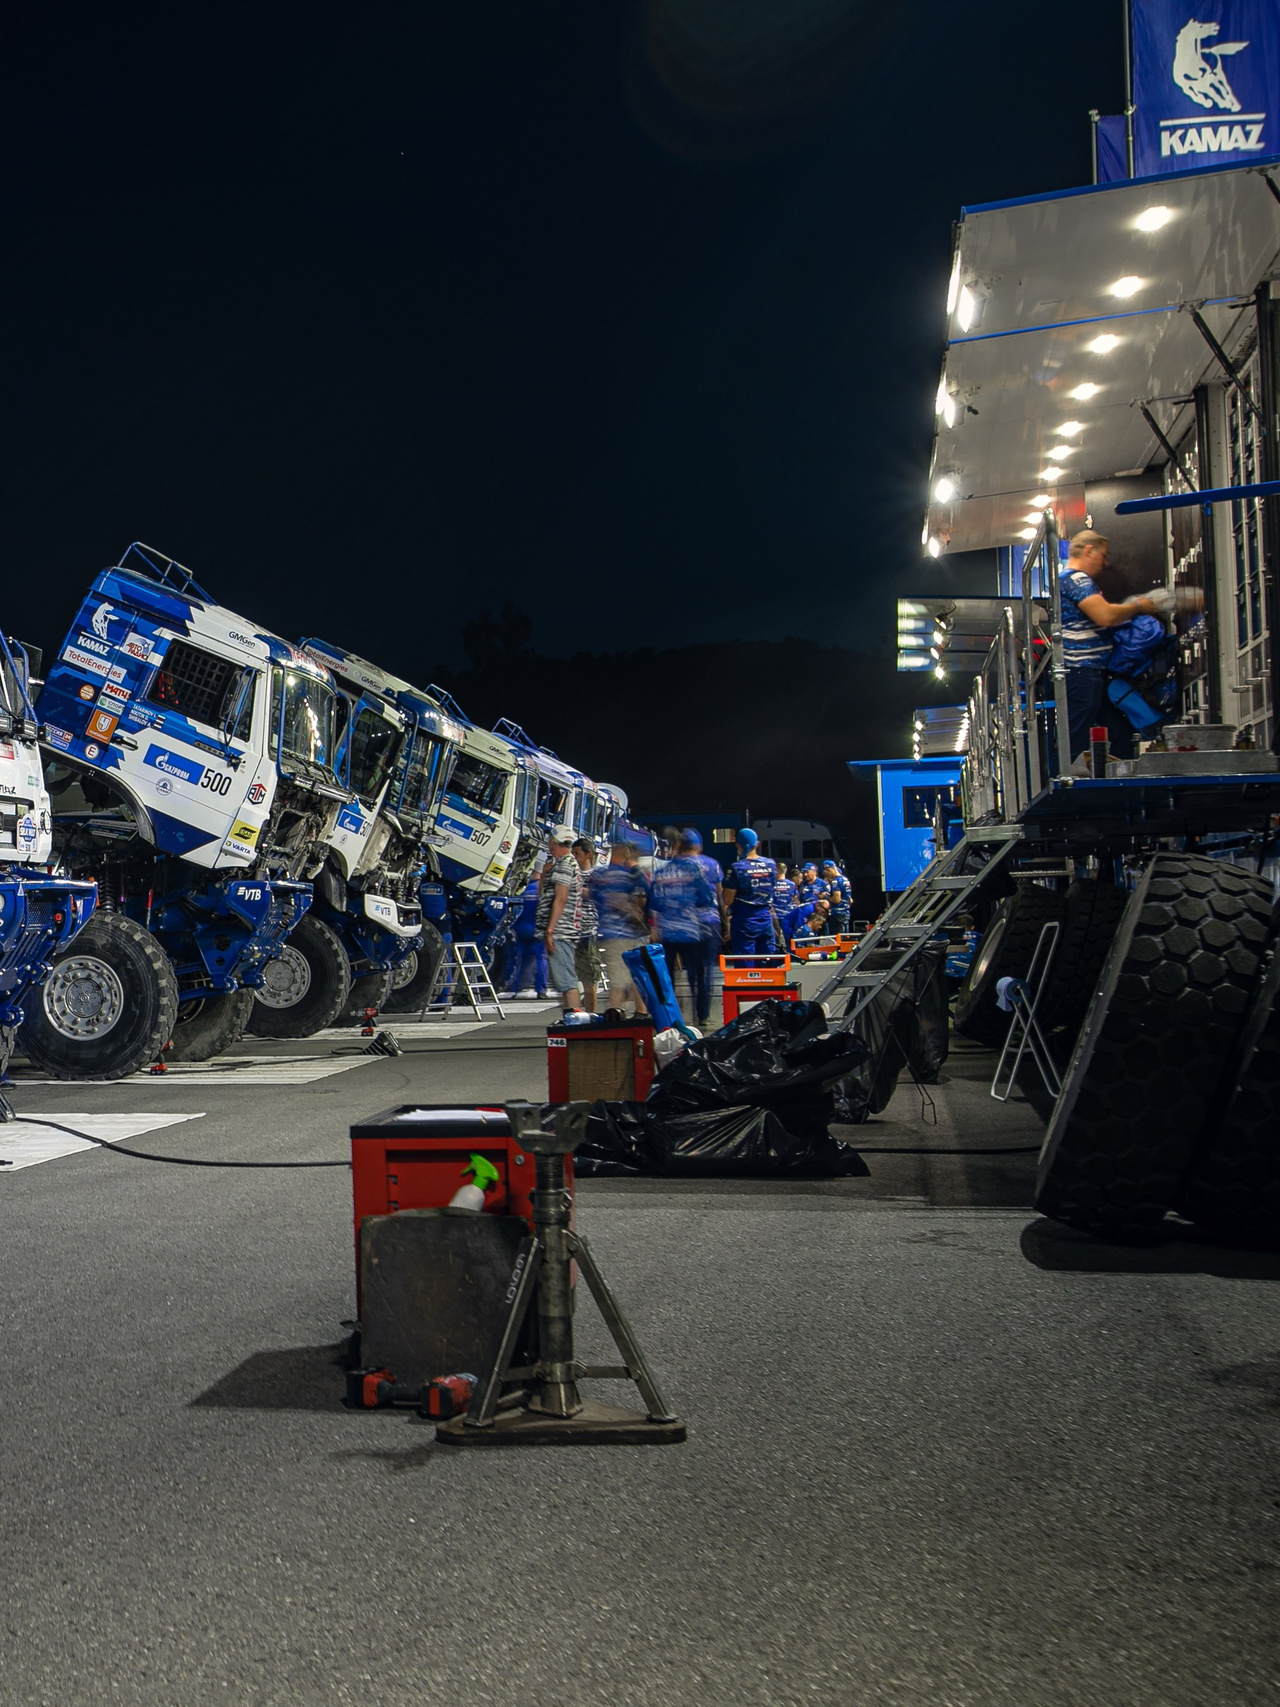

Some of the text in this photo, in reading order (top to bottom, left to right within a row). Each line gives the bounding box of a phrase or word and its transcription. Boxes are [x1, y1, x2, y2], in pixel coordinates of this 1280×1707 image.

[1161, 124, 1266, 157] KAMAZ
[77, 635, 111, 657] KAMAZ
[228, 630, 256, 648] GMGen
[68, 649, 124, 679] TotalEnergies
[164, 761, 190, 781] GAZPROM
[200, 767, 233, 797] 500
[470, 829, 491, 847] 507
[232, 843, 251, 855] VARTA
[244, 888, 262, 901] VTB
[380, 907, 391, 916] VTB
